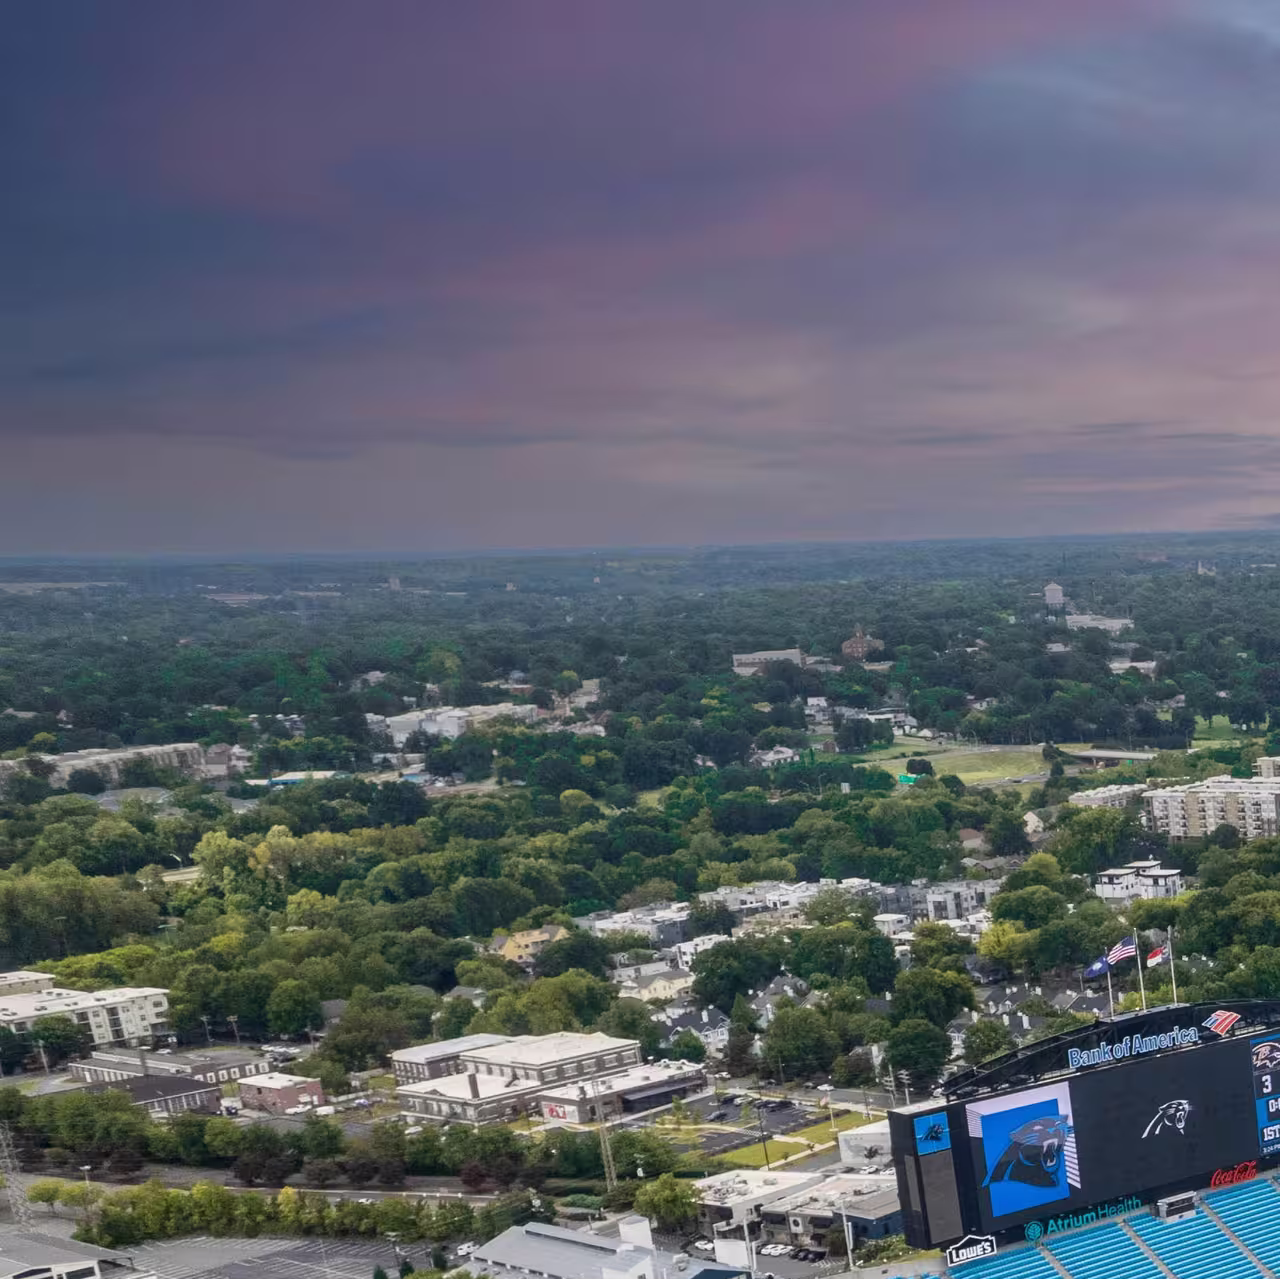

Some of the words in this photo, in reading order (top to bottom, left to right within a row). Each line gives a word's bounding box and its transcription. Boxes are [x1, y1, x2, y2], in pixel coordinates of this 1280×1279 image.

[1068, 1042, 1113, 1069] Bank
[1112, 1036, 1131, 1059] of
[1131, 1025, 1199, 1055] America
[1261, 1074, 1272, 1093] 3
[1263, 1124, 1280, 1141] 1ST
[1047, 1212, 1096, 1234] Atrium
[1097, 1196, 1141, 1220] Health
